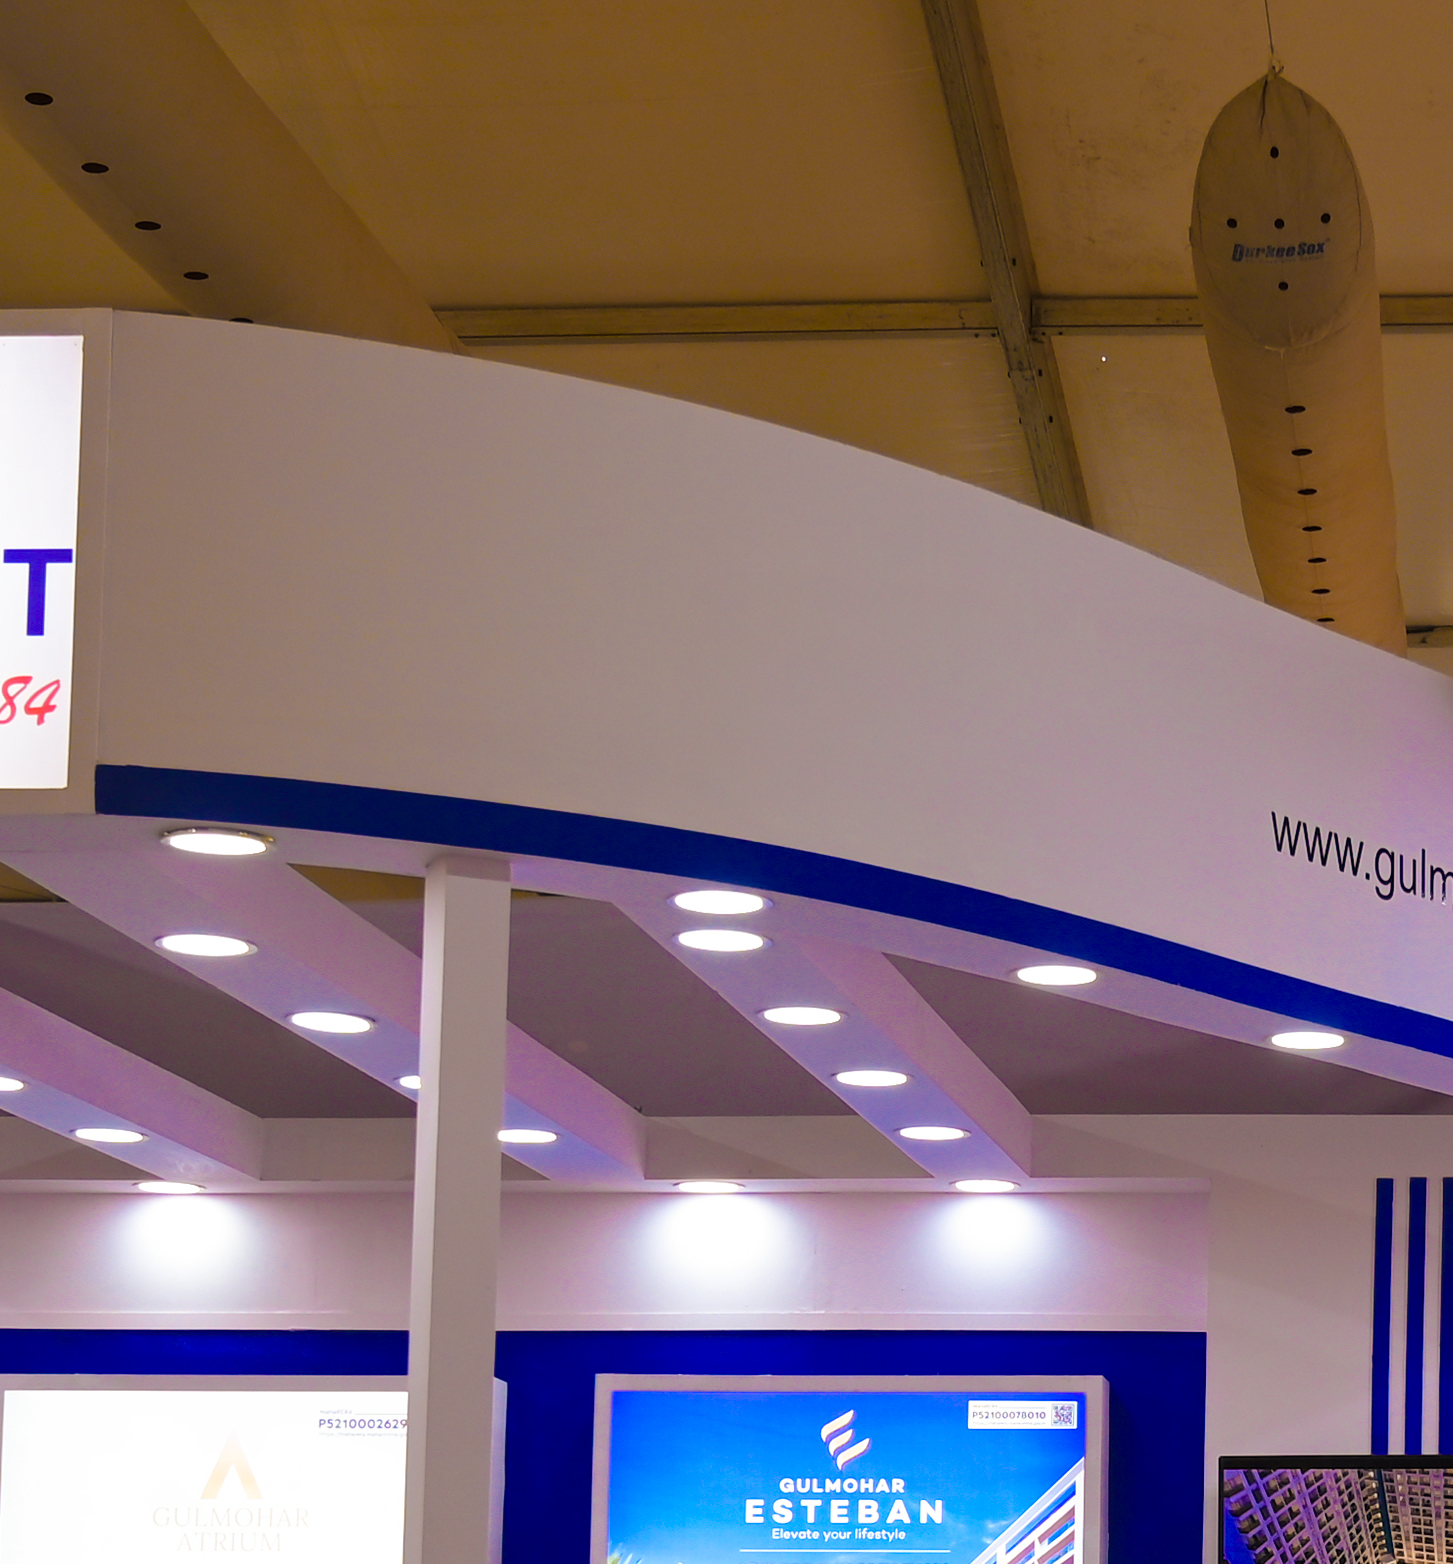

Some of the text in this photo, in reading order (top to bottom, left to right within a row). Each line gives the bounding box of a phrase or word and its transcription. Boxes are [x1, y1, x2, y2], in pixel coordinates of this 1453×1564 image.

[319, 1418, 407, 1429] P5210002629
[779, 1478, 905, 1493] GULMOHAR
[153, 1507, 309, 1527] GULMOHAR
[745, 1499, 945, 1524] ESTEBAN
[177, 1532, 281, 1552] ATRIUM
[772, 1528, 906, 1542] Elevate your lifestyle
